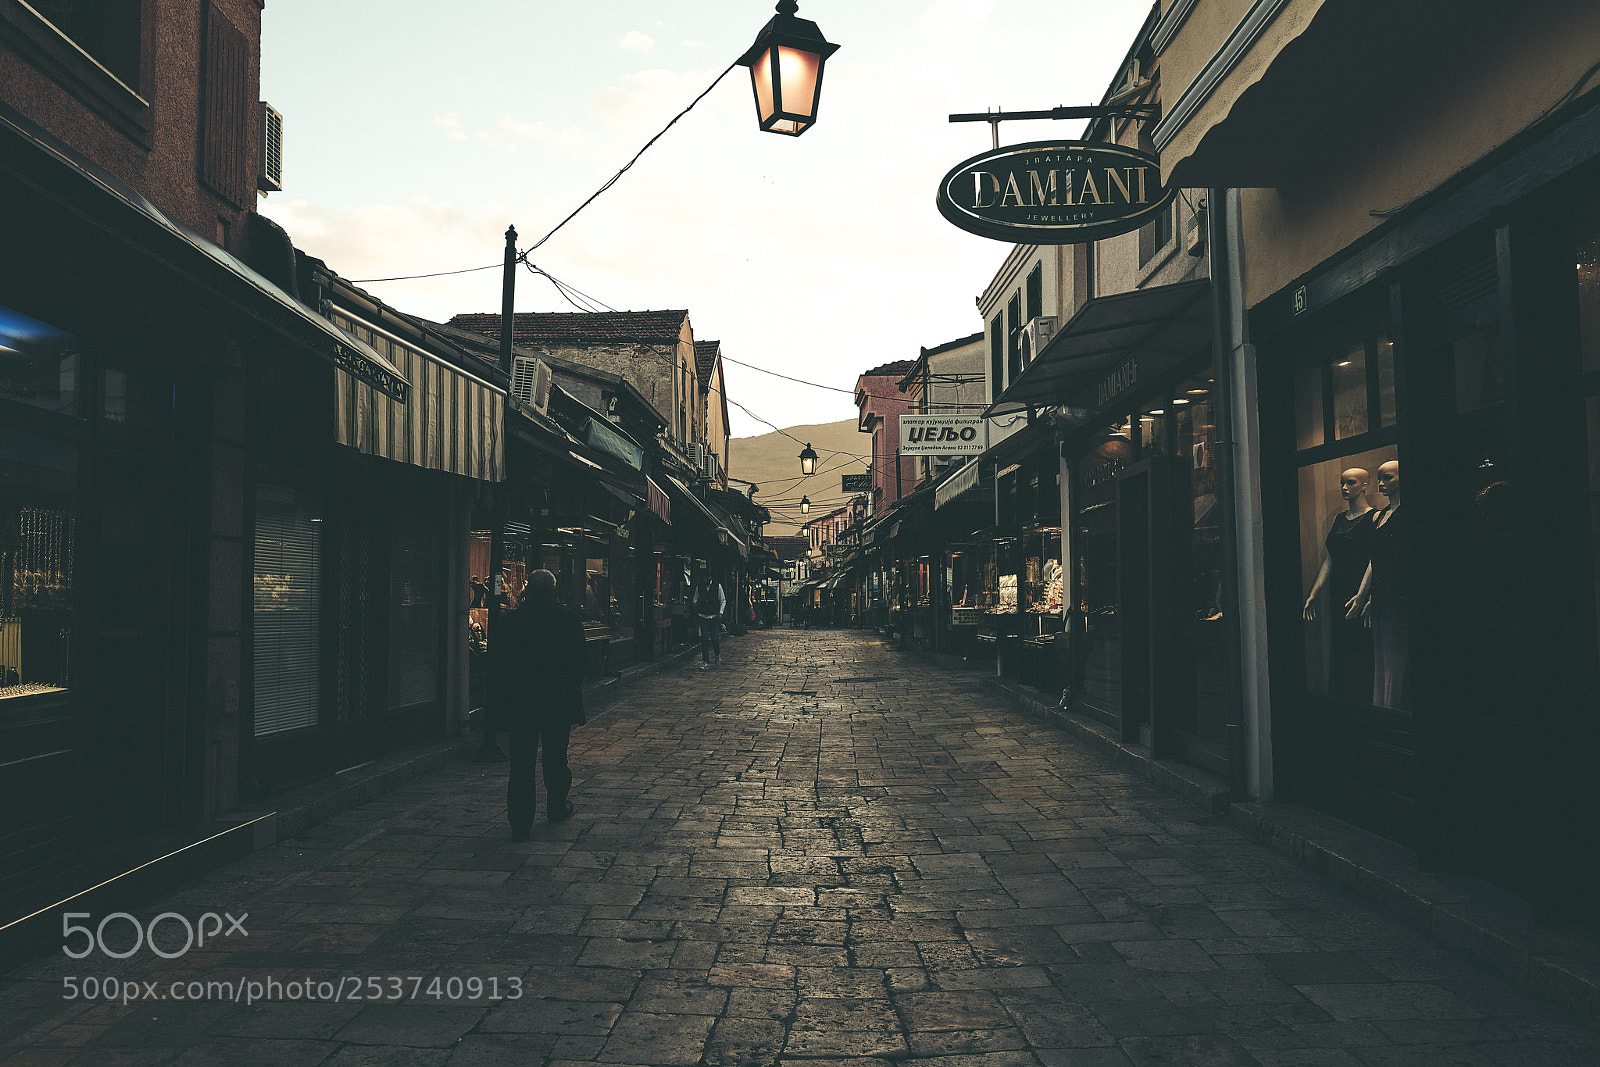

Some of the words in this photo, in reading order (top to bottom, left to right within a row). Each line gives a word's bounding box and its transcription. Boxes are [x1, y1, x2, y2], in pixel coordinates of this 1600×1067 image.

[970, 166, 1149, 208] DAMIANI
[1026, 212, 1095, 222] JEWELLERY
[908, 426, 977, 444] ЏЕЉО
